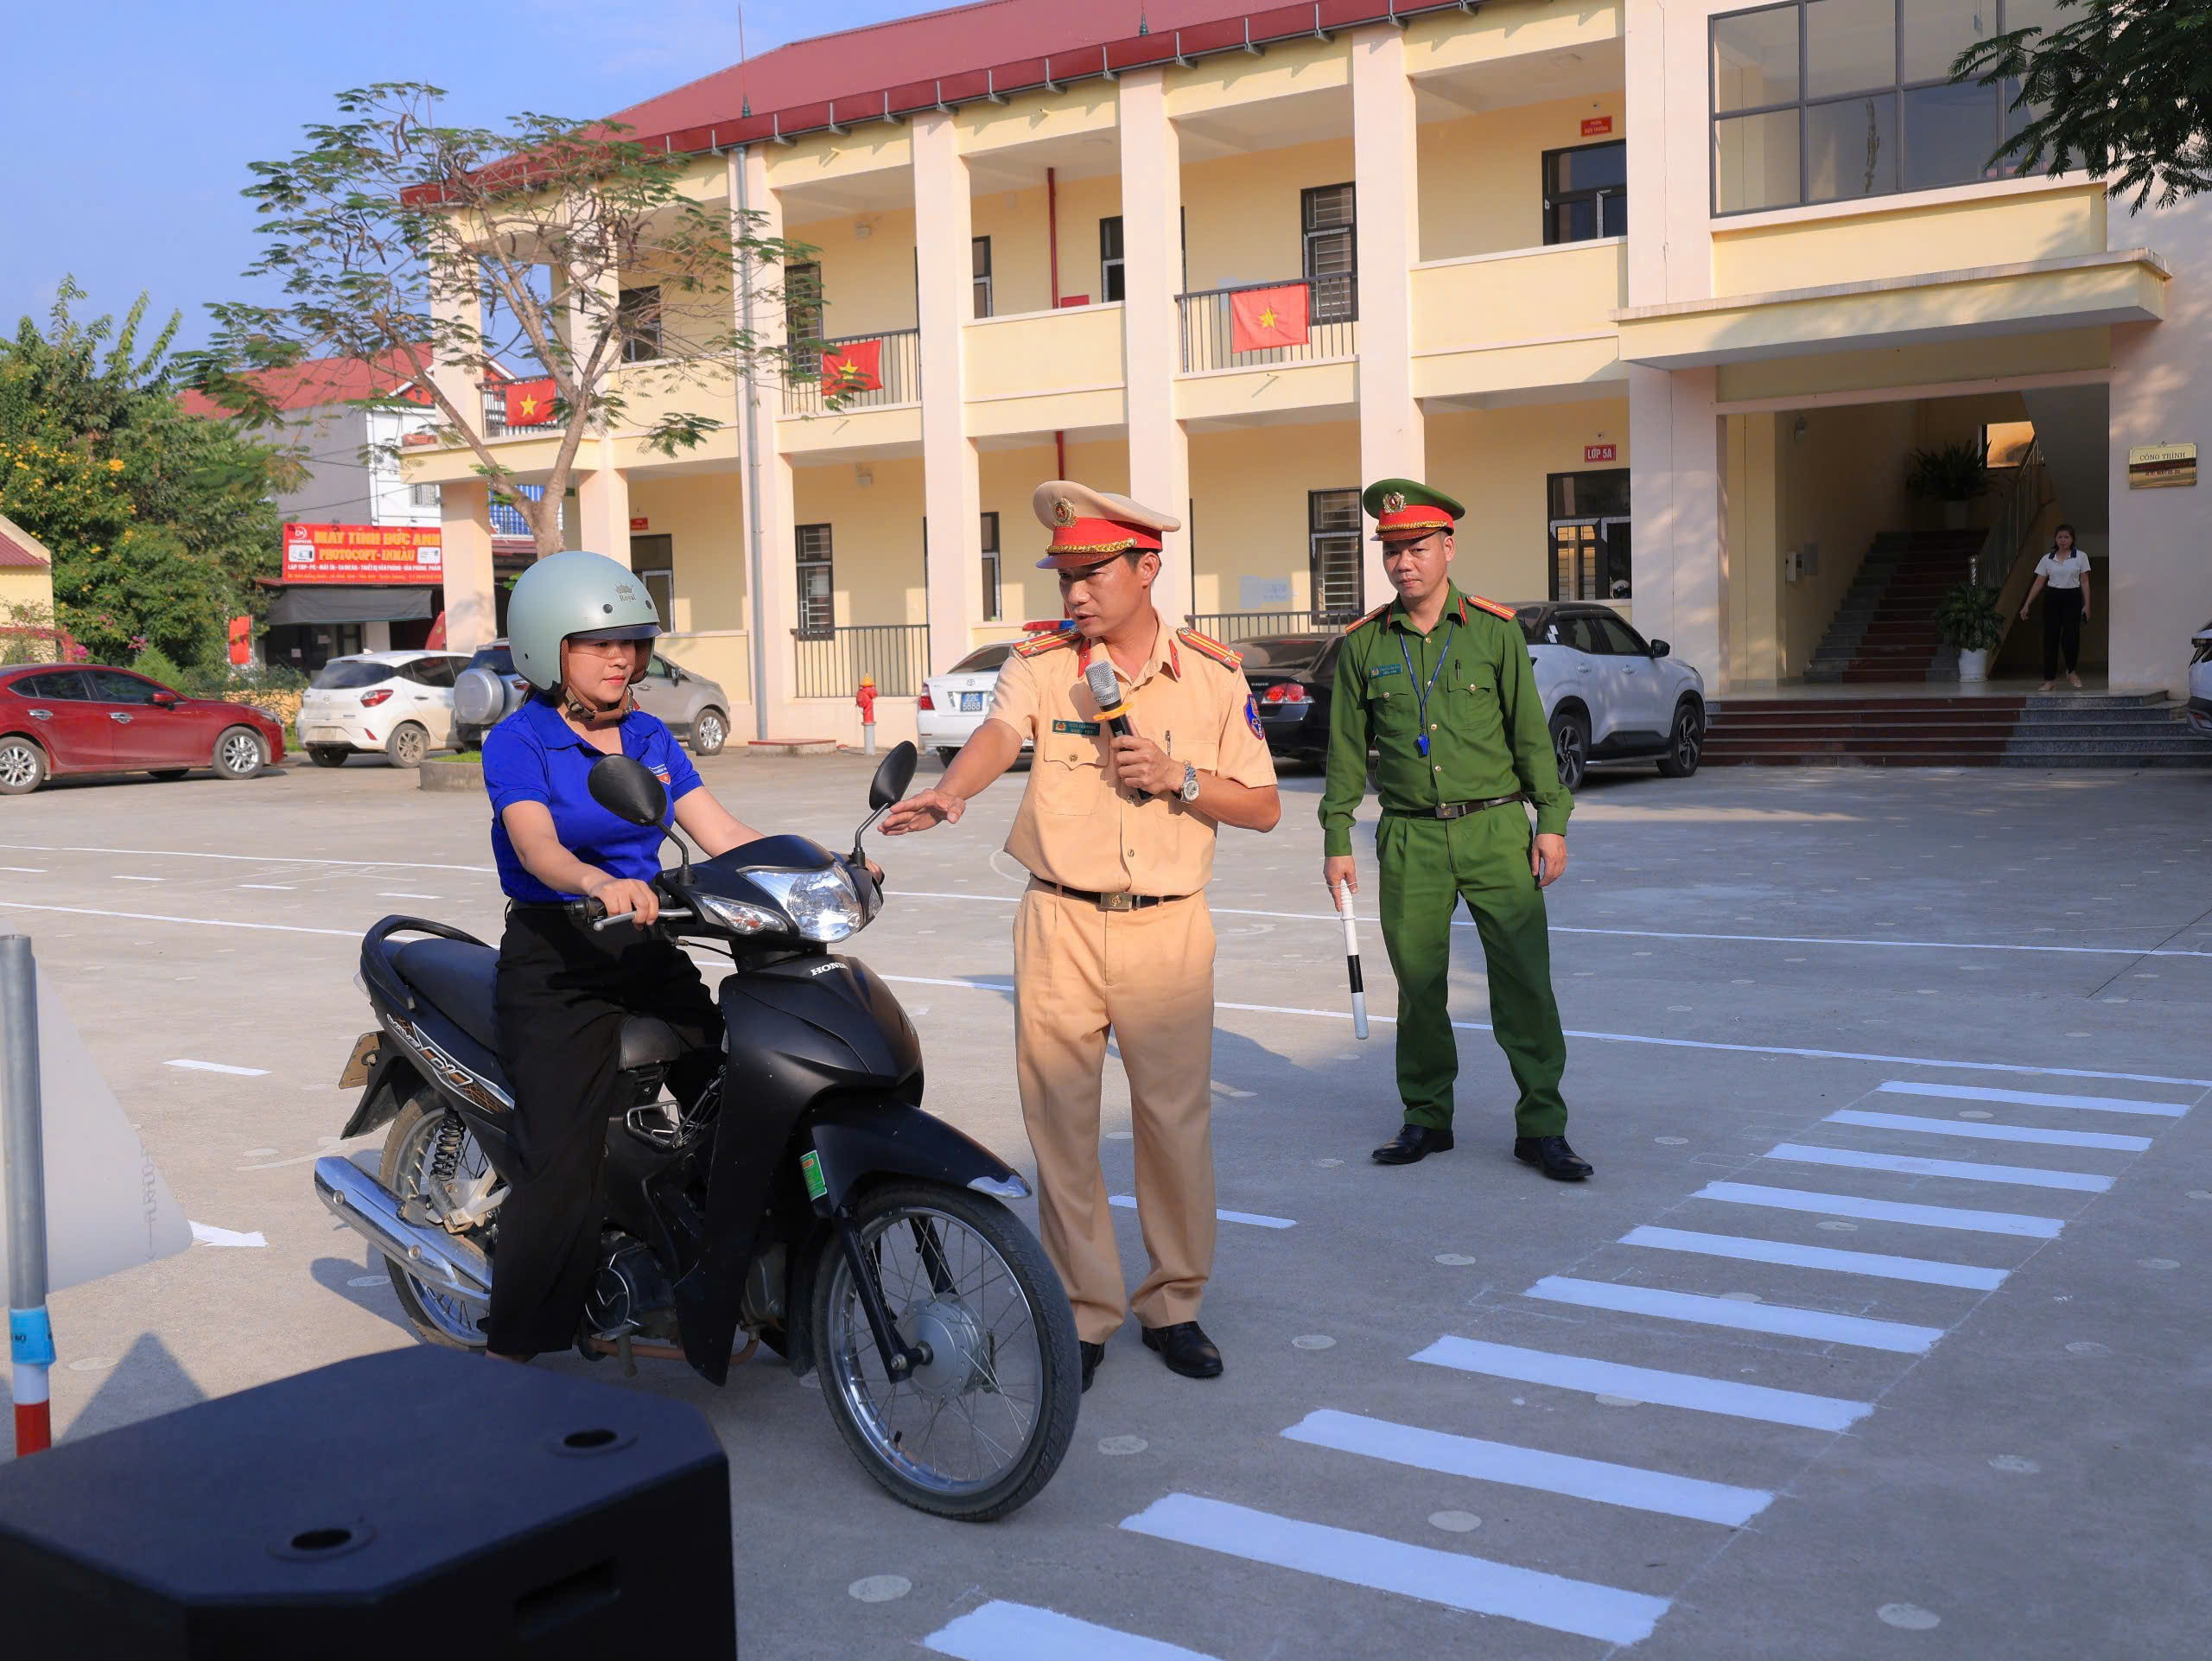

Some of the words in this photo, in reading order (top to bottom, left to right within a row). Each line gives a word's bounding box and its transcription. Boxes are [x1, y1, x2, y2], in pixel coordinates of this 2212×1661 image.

[1603, 448, 1612, 458] 5A
[412, 531, 442, 546] ANH
[620, 594, 637, 602] Royal
